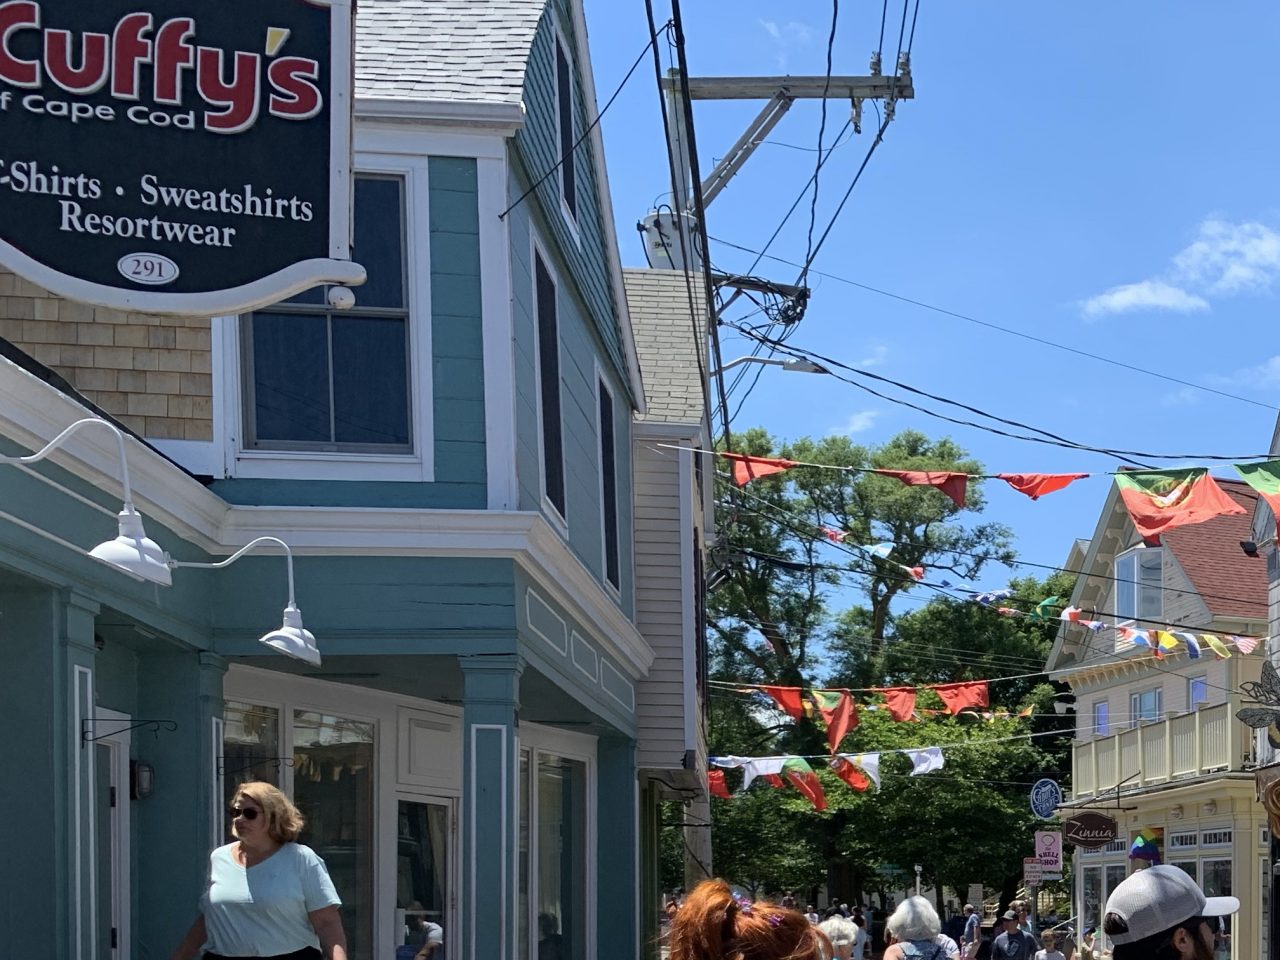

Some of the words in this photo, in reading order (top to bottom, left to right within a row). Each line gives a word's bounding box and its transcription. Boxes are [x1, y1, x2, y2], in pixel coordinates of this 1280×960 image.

[0, 0, 324, 134] Cuffy's
[22, 95, 116, 123] Cape
[126, 105, 196, 130] Cod
[0, 160, 101, 200] -Shirts
[140, 174, 314, 222] Sweatshirts
[58, 199, 237, 248] Resortwear
[131, 257, 165, 278] 291
[1067, 820, 1115, 841] Zinnia
